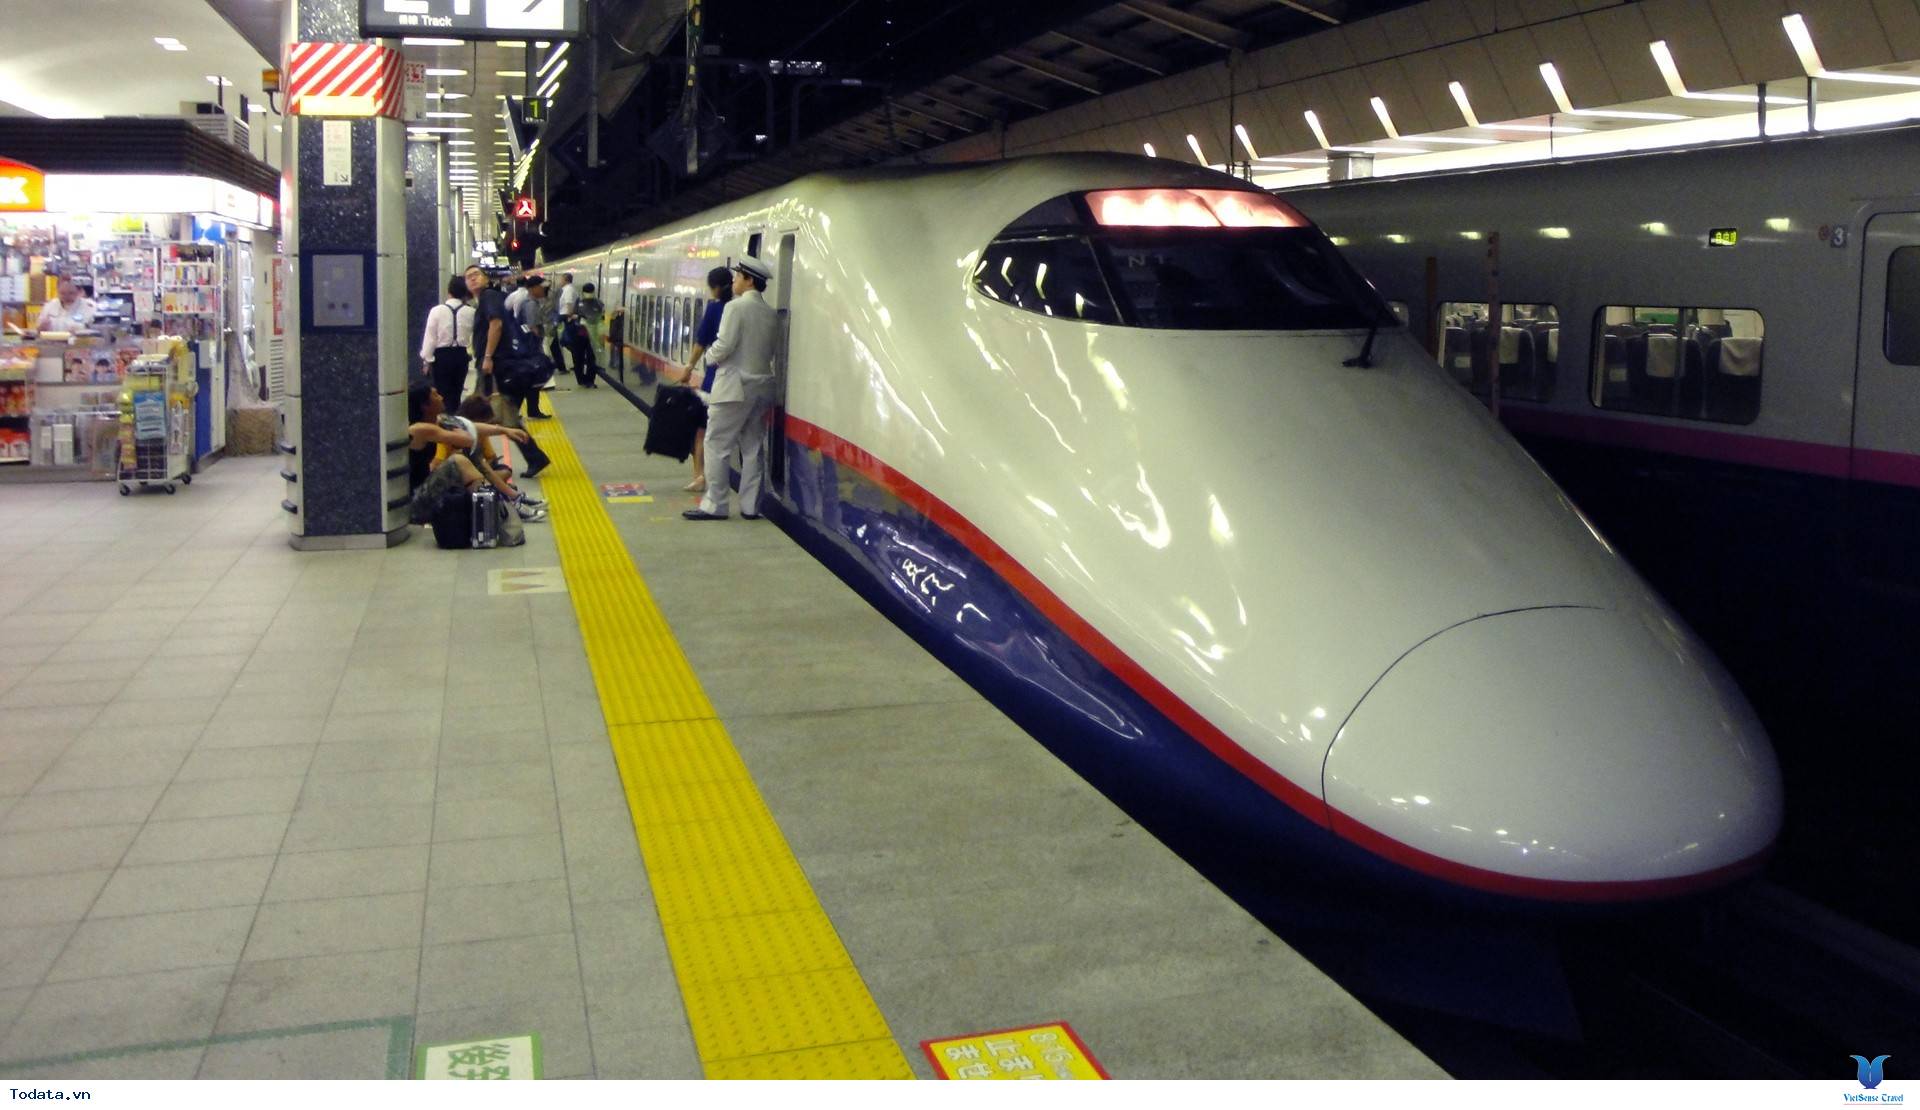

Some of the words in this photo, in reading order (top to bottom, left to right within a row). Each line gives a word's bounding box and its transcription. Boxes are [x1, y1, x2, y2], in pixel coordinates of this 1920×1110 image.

[421, 15, 452, 27] Track
[530, 100, 539, 118] 1
[1834, 227, 1844, 246] 3
